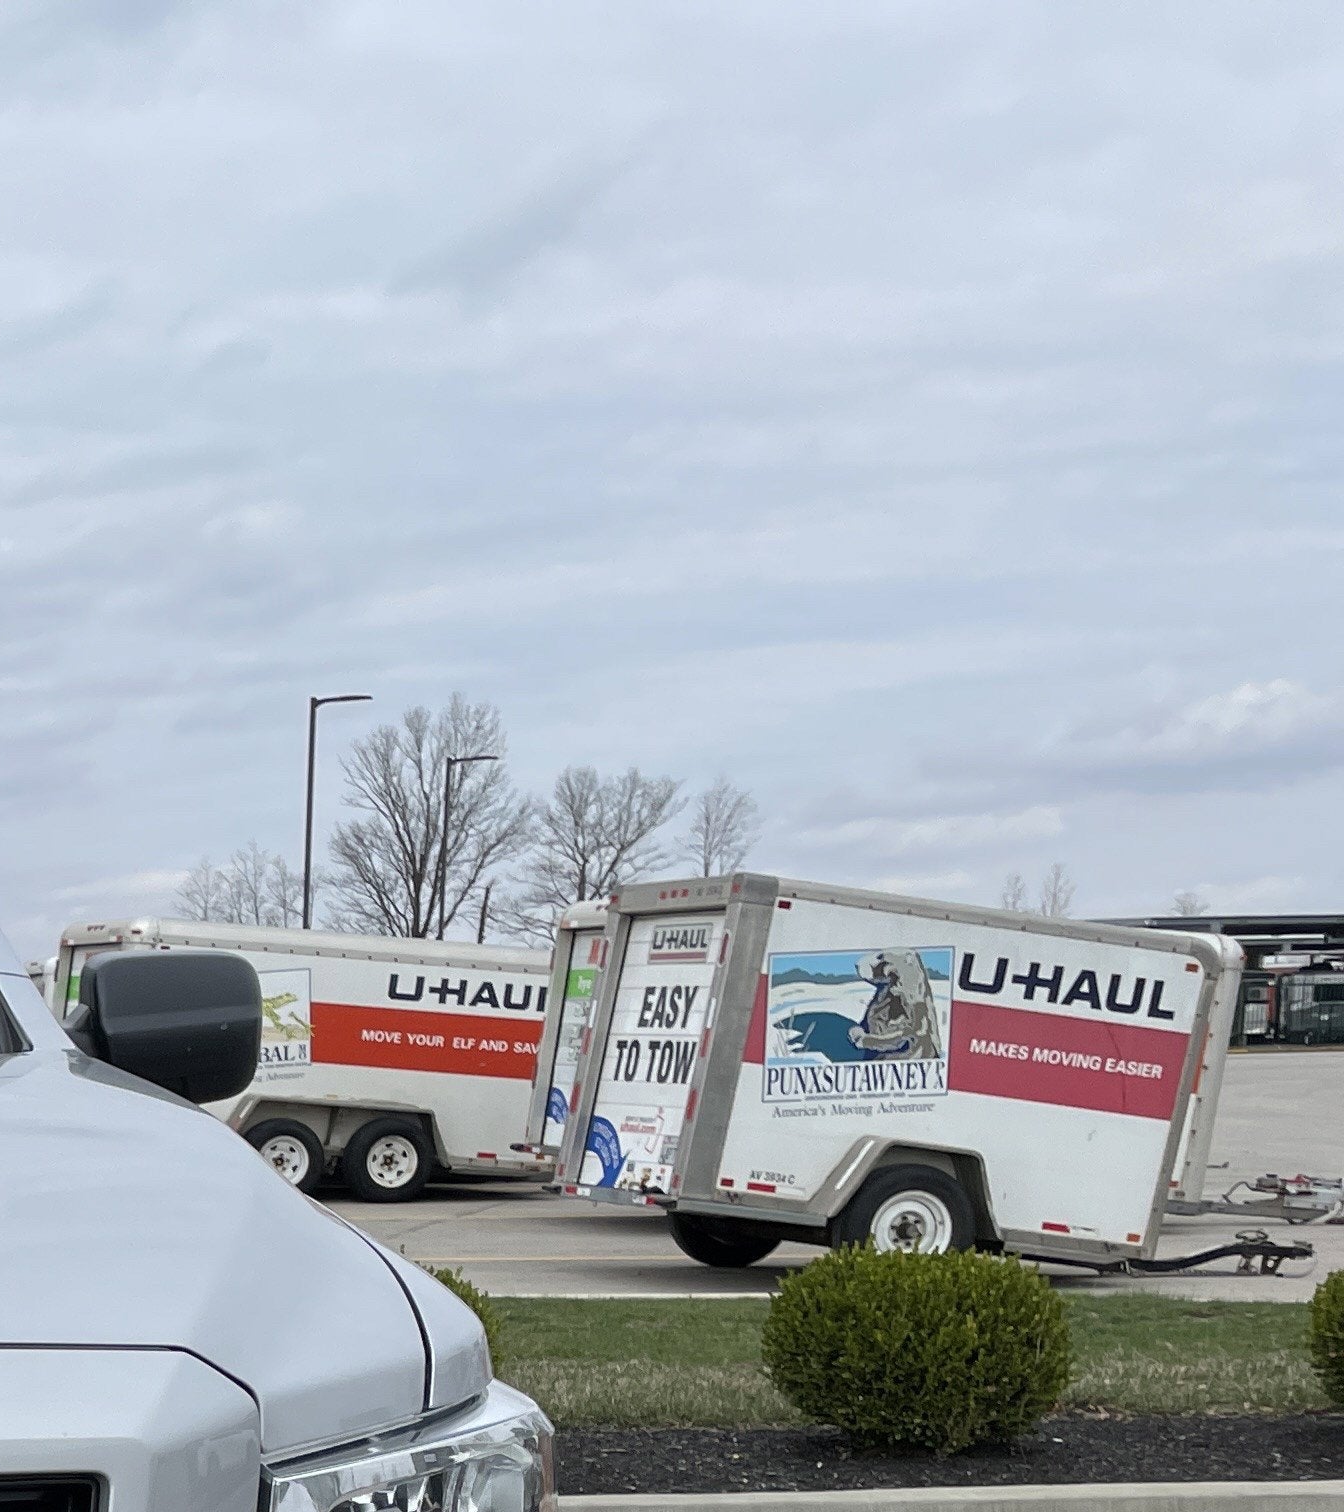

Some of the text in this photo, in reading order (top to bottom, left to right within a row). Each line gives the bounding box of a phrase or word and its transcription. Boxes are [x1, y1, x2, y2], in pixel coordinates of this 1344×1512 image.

[652, 928, 708, 950] U-HAUL
[958, 952, 1176, 1021] U-HAUL
[637, 985, 700, 1029] EASY
[361, 1028, 403, 1044] MOVE
[406, 1032, 445, 1047] YOUR
[478, 1038, 509, 1053] AND
[969, 1037, 1164, 1081] MAKES MOVING EASIER
[613, 1039, 698, 1085] TO TOW
[766, 1062, 932, 1096] PUNXSUTAWNEY
[772, 1100, 937, 1118] America's Moving Adventure
